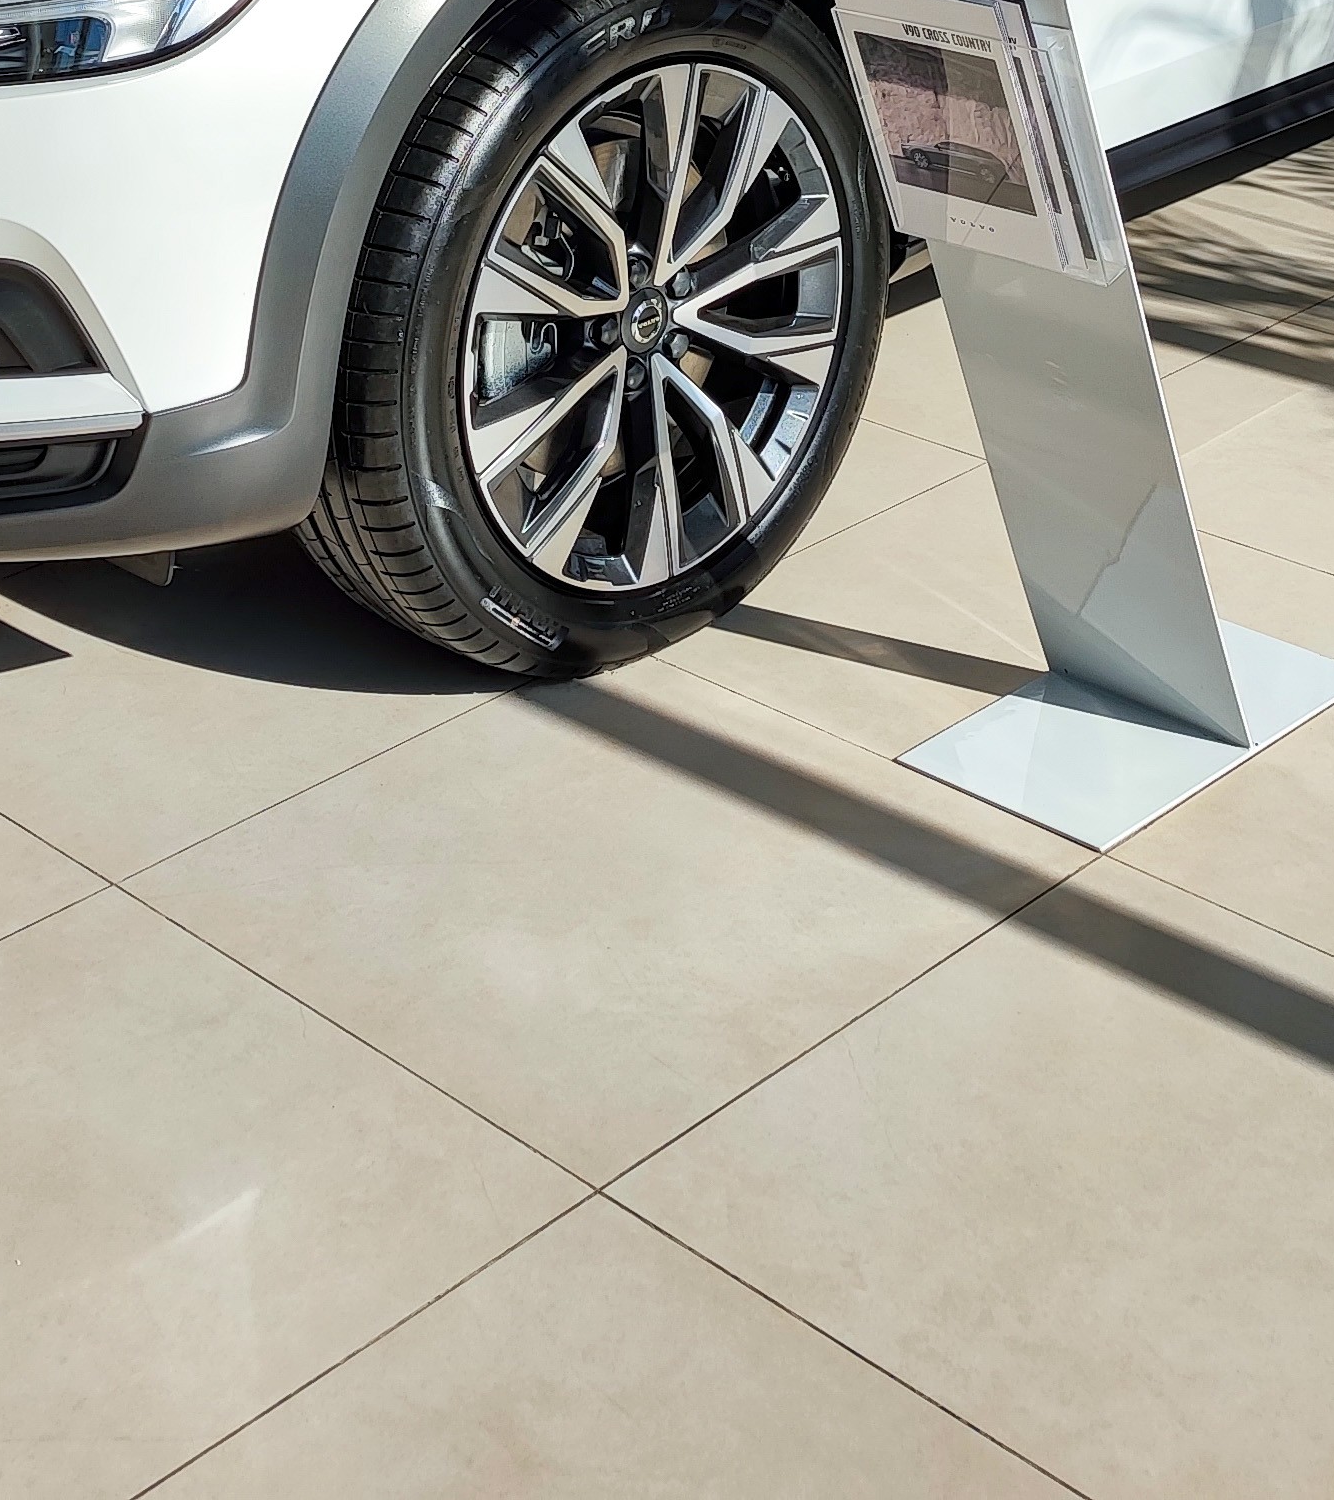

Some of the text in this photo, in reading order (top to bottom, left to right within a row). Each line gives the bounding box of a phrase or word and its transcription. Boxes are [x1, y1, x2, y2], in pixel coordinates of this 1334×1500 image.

[901, 23, 921, 38] V90
[922, 27, 950, 44] CROSS
[951, 33, 992, 53] COUNTRY
[950, 216, 995, 233] VOLVO
